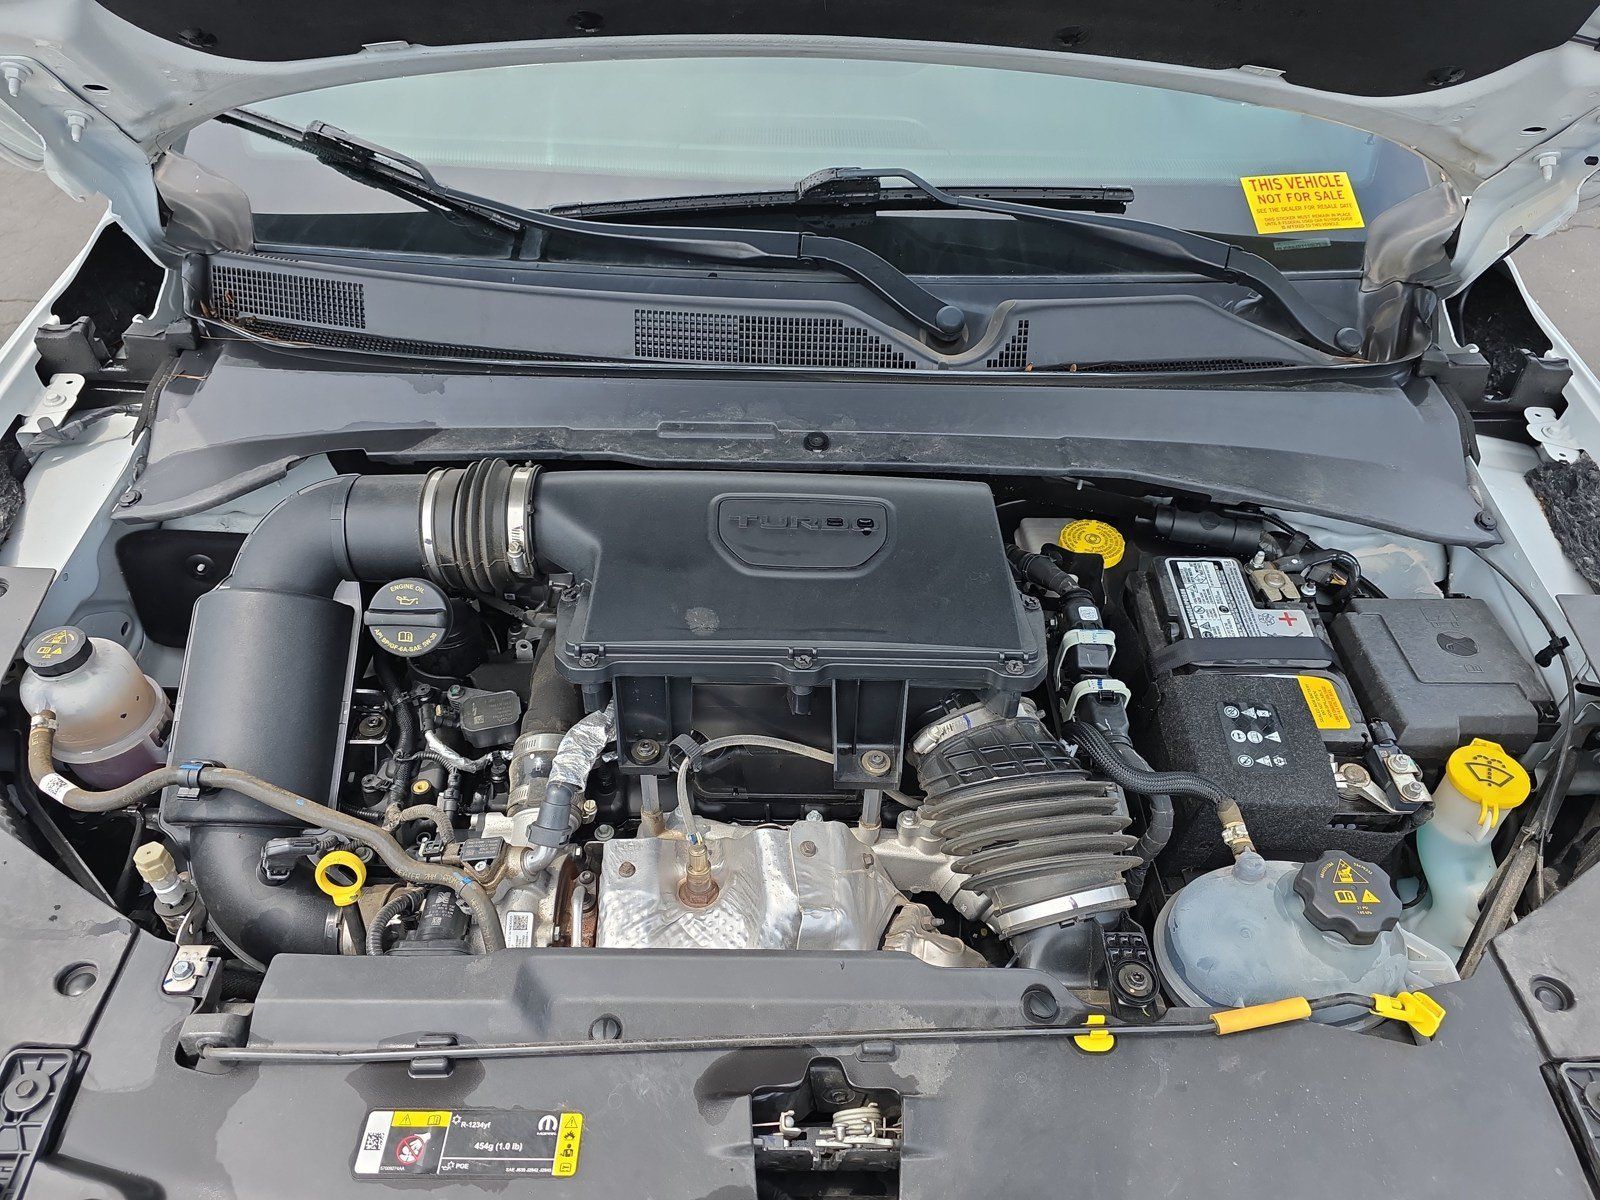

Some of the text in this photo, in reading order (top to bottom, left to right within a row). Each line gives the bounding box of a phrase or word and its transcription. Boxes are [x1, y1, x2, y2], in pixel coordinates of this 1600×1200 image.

[1249, 175, 1344, 192] THIS VEHICLE
[1257, 190, 1345, 204] NOT FOR SALE
[728, 514, 880, 534] TURBO
[390, 584, 425, 594] ENGINE OIL
[374, 629, 384, 640] API
[395, 866, 420, 880] HEATER
[460, 1121, 491, 1130] R-1234yf
[474, 1142, 523, 1152] 454g (1.0 lb)
